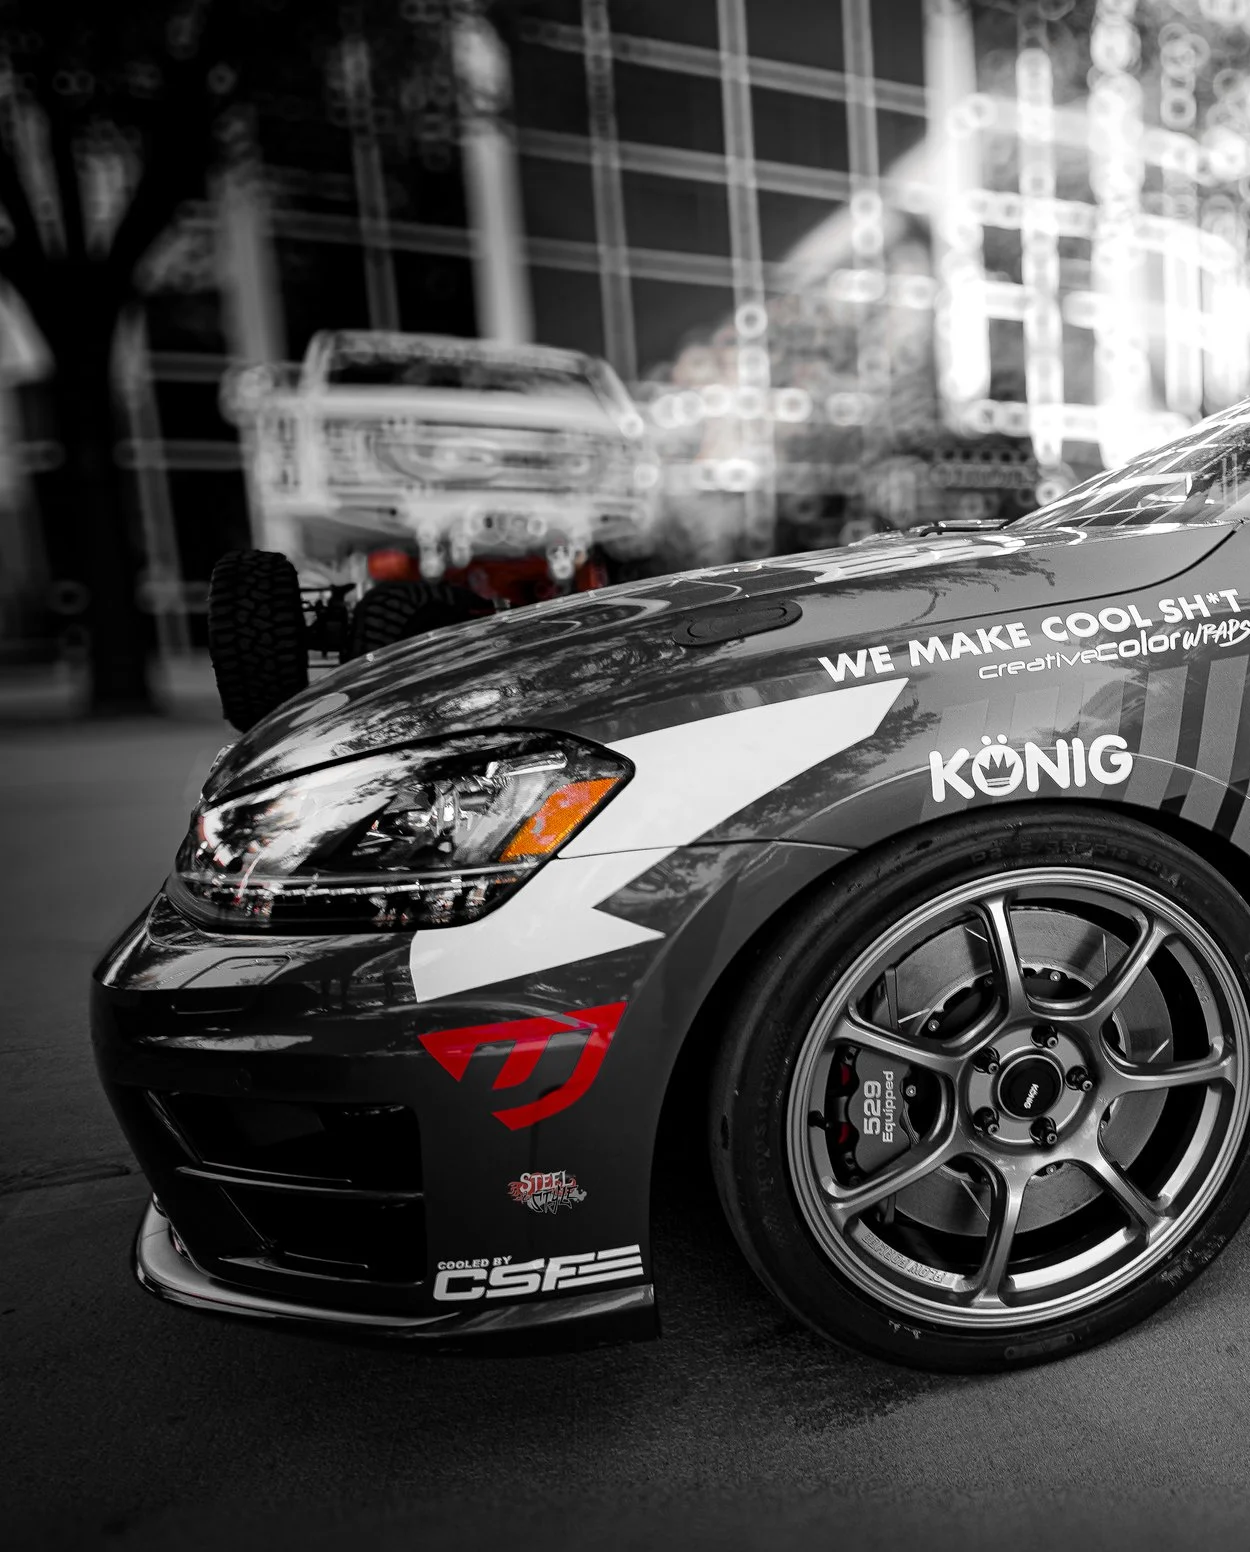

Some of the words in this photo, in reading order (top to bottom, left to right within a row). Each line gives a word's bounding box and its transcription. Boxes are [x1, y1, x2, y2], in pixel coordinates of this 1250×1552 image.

[817, 645, 896, 684] WE
[907, 621, 1032, 667] MAKE
[1040, 603, 1153, 642] COOL
[929, 733, 1134, 803] KÖNIG
[863, 1080, 882, 1136] 529
[882, 1070, 897, 1143] Equipped
[519, 1169, 574, 1193] STEEL
[437, 1258, 490, 1270] COOLED
[492, 1255, 513, 1267] BY
